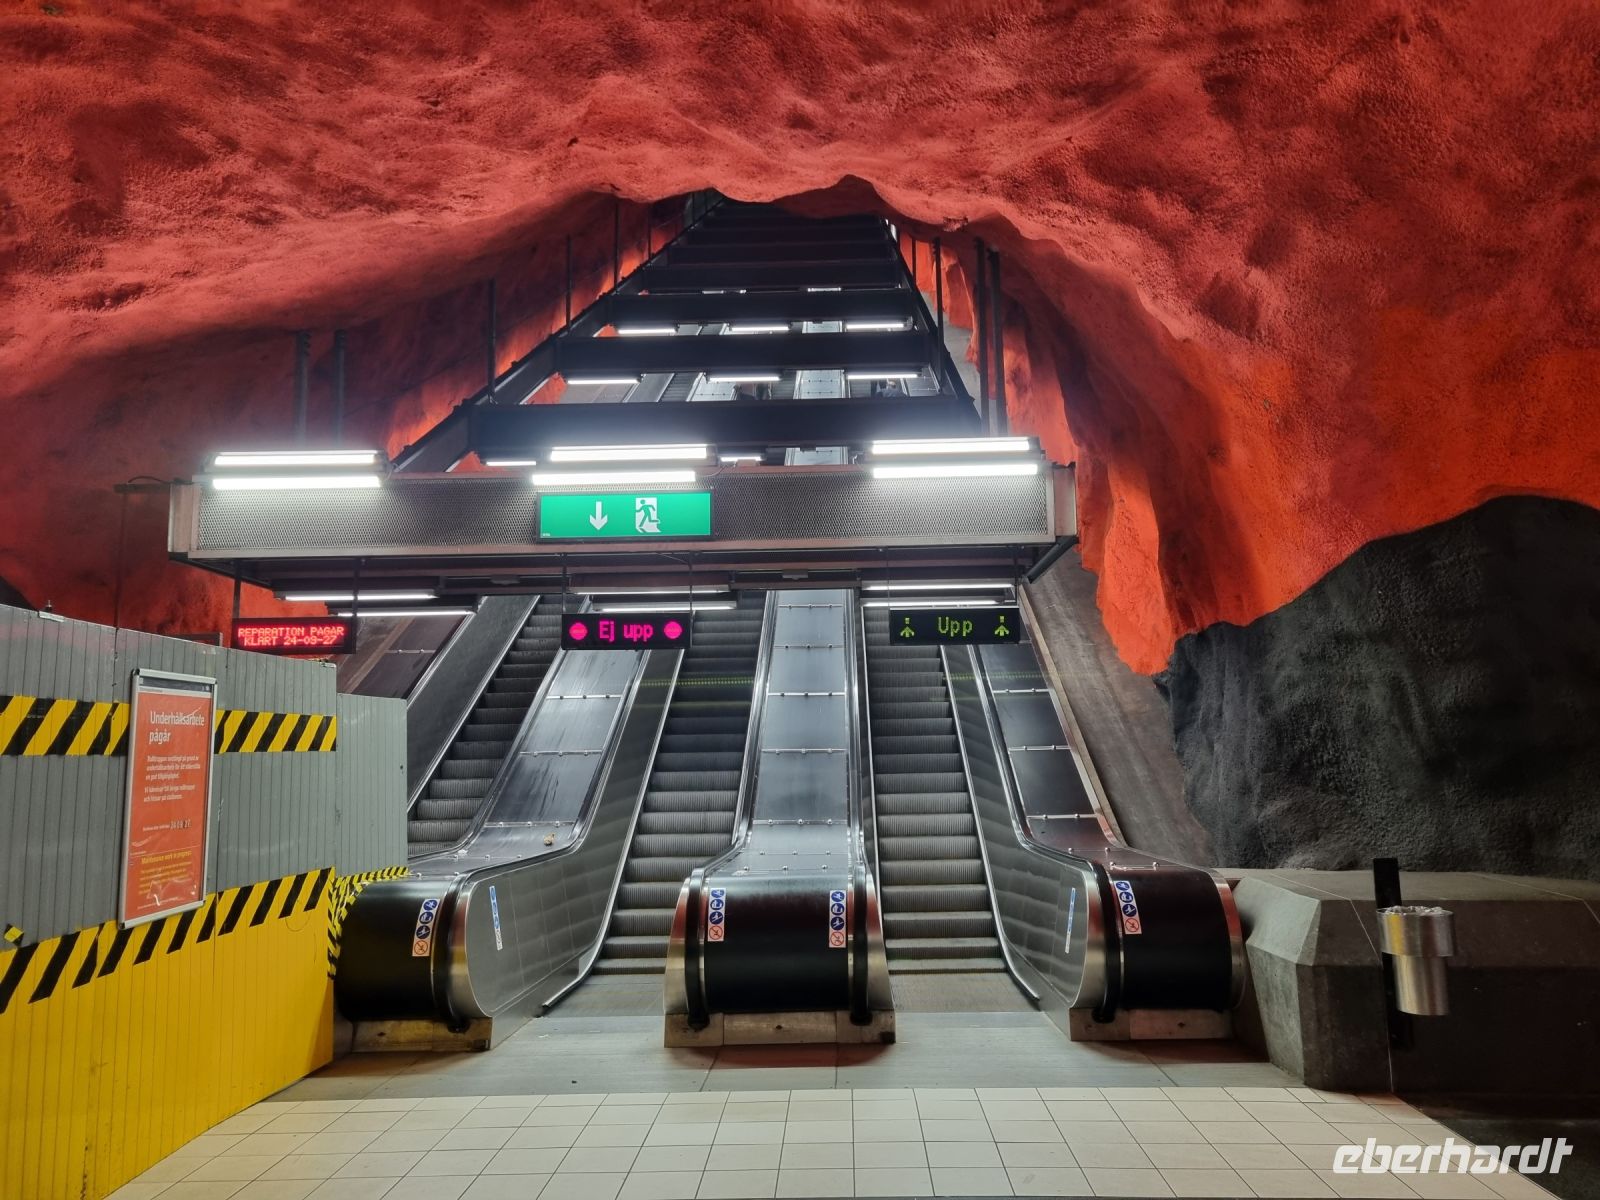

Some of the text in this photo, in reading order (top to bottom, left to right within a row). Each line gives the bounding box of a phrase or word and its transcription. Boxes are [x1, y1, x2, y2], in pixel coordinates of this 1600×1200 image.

[238, 626, 305, 638] REPARATION
[599, 620, 654, 643] Ej upp
[938, 616, 973, 637] Upp
[243, 634, 337, 647] KLART 24-09-27
[148, 727, 171, 745] pågår
